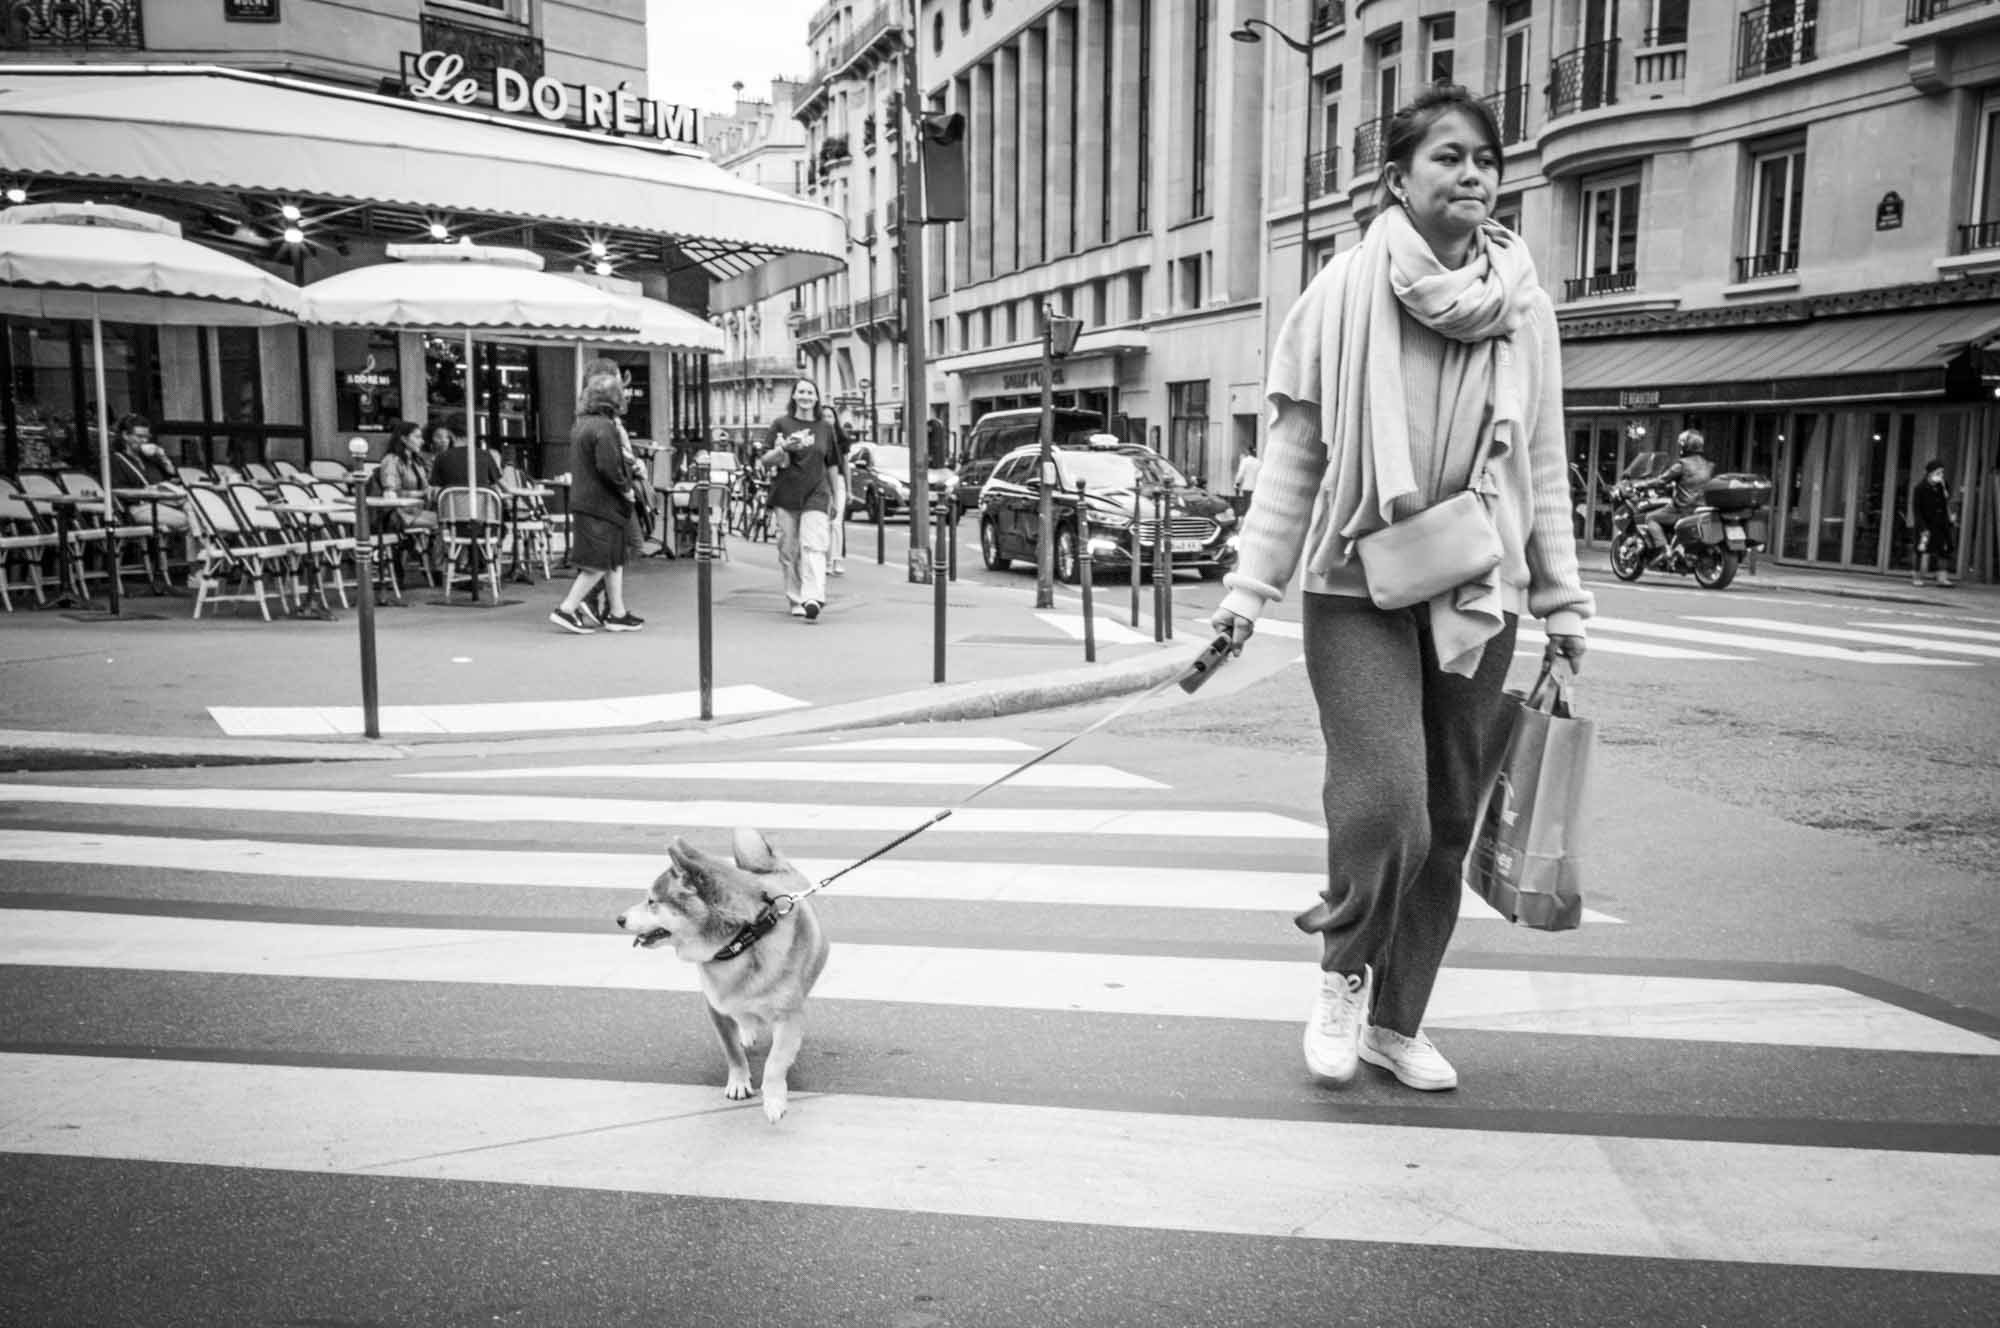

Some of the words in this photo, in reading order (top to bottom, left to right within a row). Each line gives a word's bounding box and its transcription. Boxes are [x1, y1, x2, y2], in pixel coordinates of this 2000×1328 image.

[410, 50, 479, 104] Le
[496, 67, 569, 121] DO
[656, 98, 705, 145] MI
